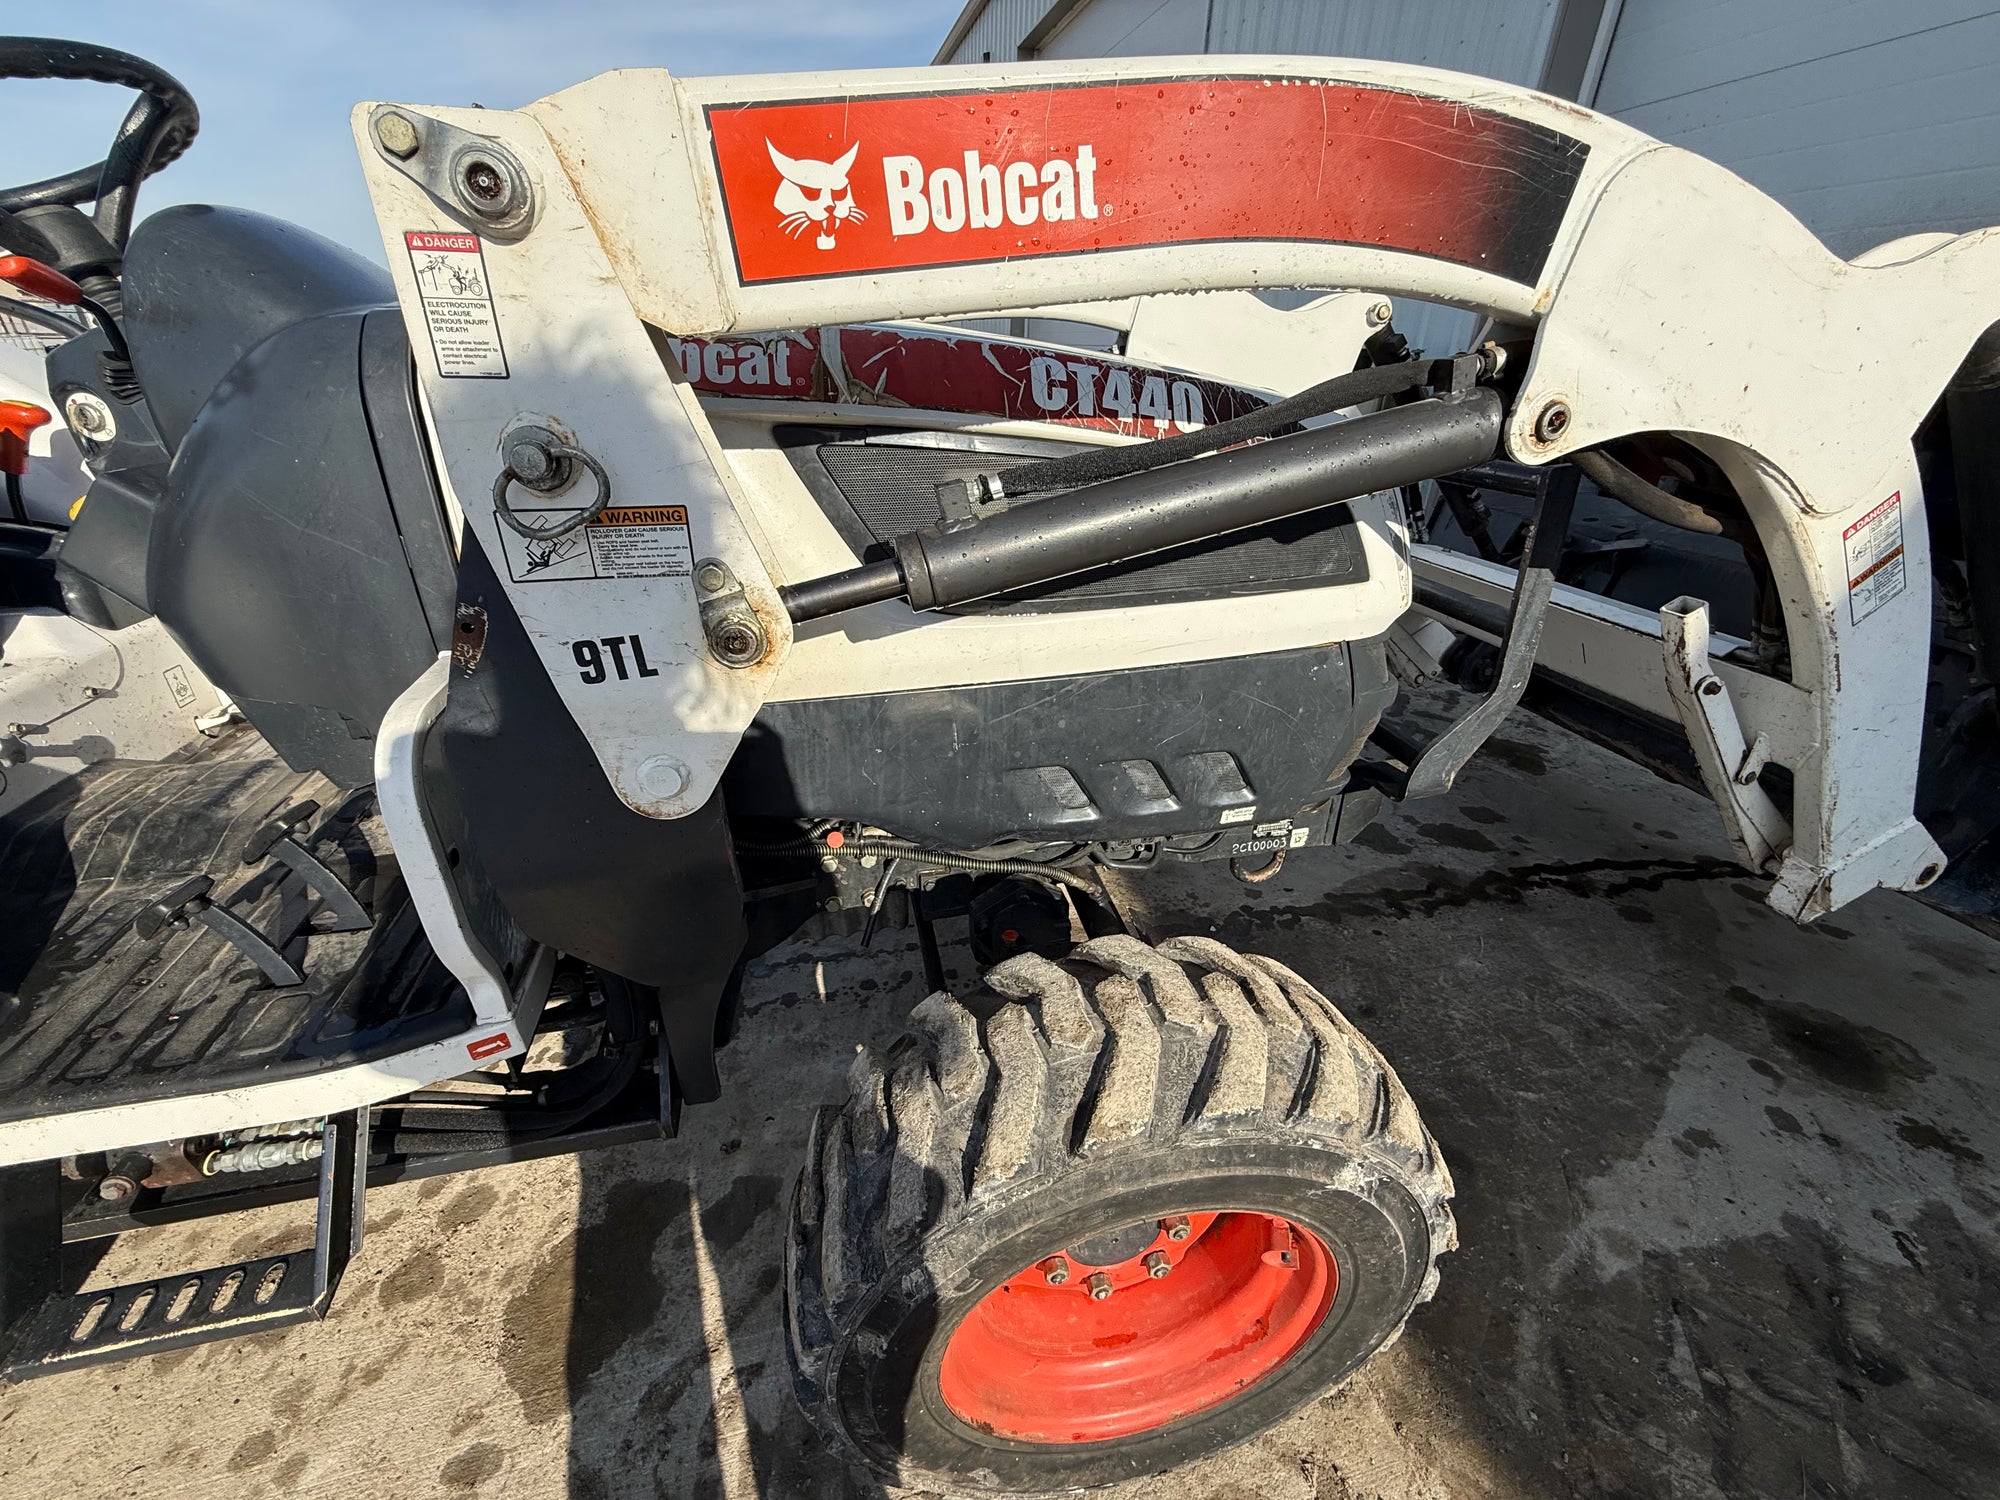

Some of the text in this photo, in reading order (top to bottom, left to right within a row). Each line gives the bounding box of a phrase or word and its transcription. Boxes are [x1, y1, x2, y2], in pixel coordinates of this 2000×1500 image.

[882, 145, 1098, 236] Bobcat
[424, 236, 475, 249] DANGER
[427, 301, 487, 309] ELECTROCUTION
[668, 338, 791, 386] bcat
[1030, 356, 1206, 433] CT440
[605, 510, 683, 523] WARNING
[1855, 495, 1898, 530] DANGER
[1859, 547, 1901, 581] WARNING
[572, 634, 659, 684] 9TL
